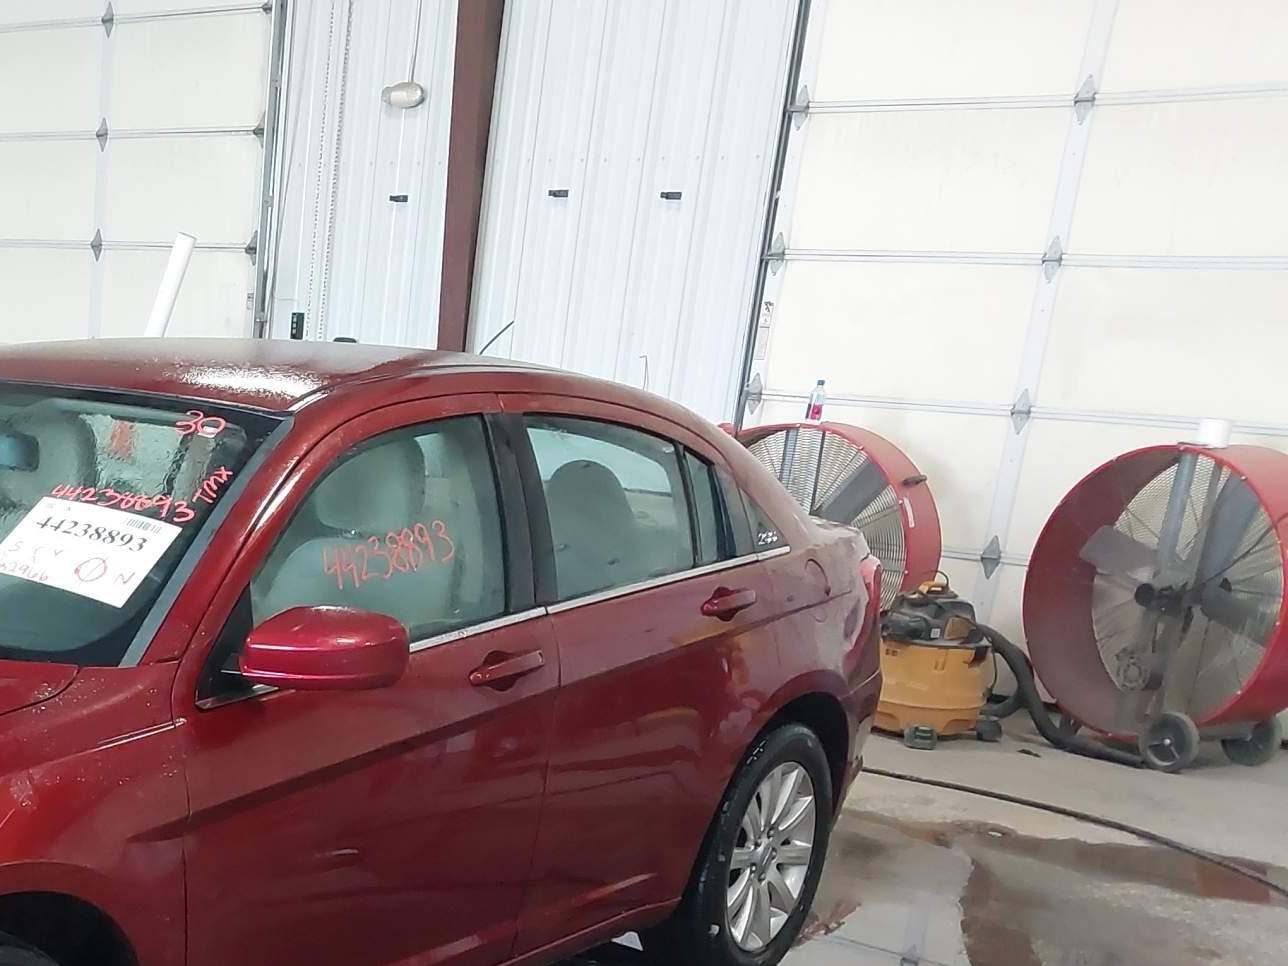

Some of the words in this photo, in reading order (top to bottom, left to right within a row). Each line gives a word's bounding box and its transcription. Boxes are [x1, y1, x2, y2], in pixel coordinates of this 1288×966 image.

[175, 410, 226, 435] 30
[52, 484, 196, 522] 44238893
[36, 516, 148, 552] 44238893
[322, 519, 455, 590] 44238893
